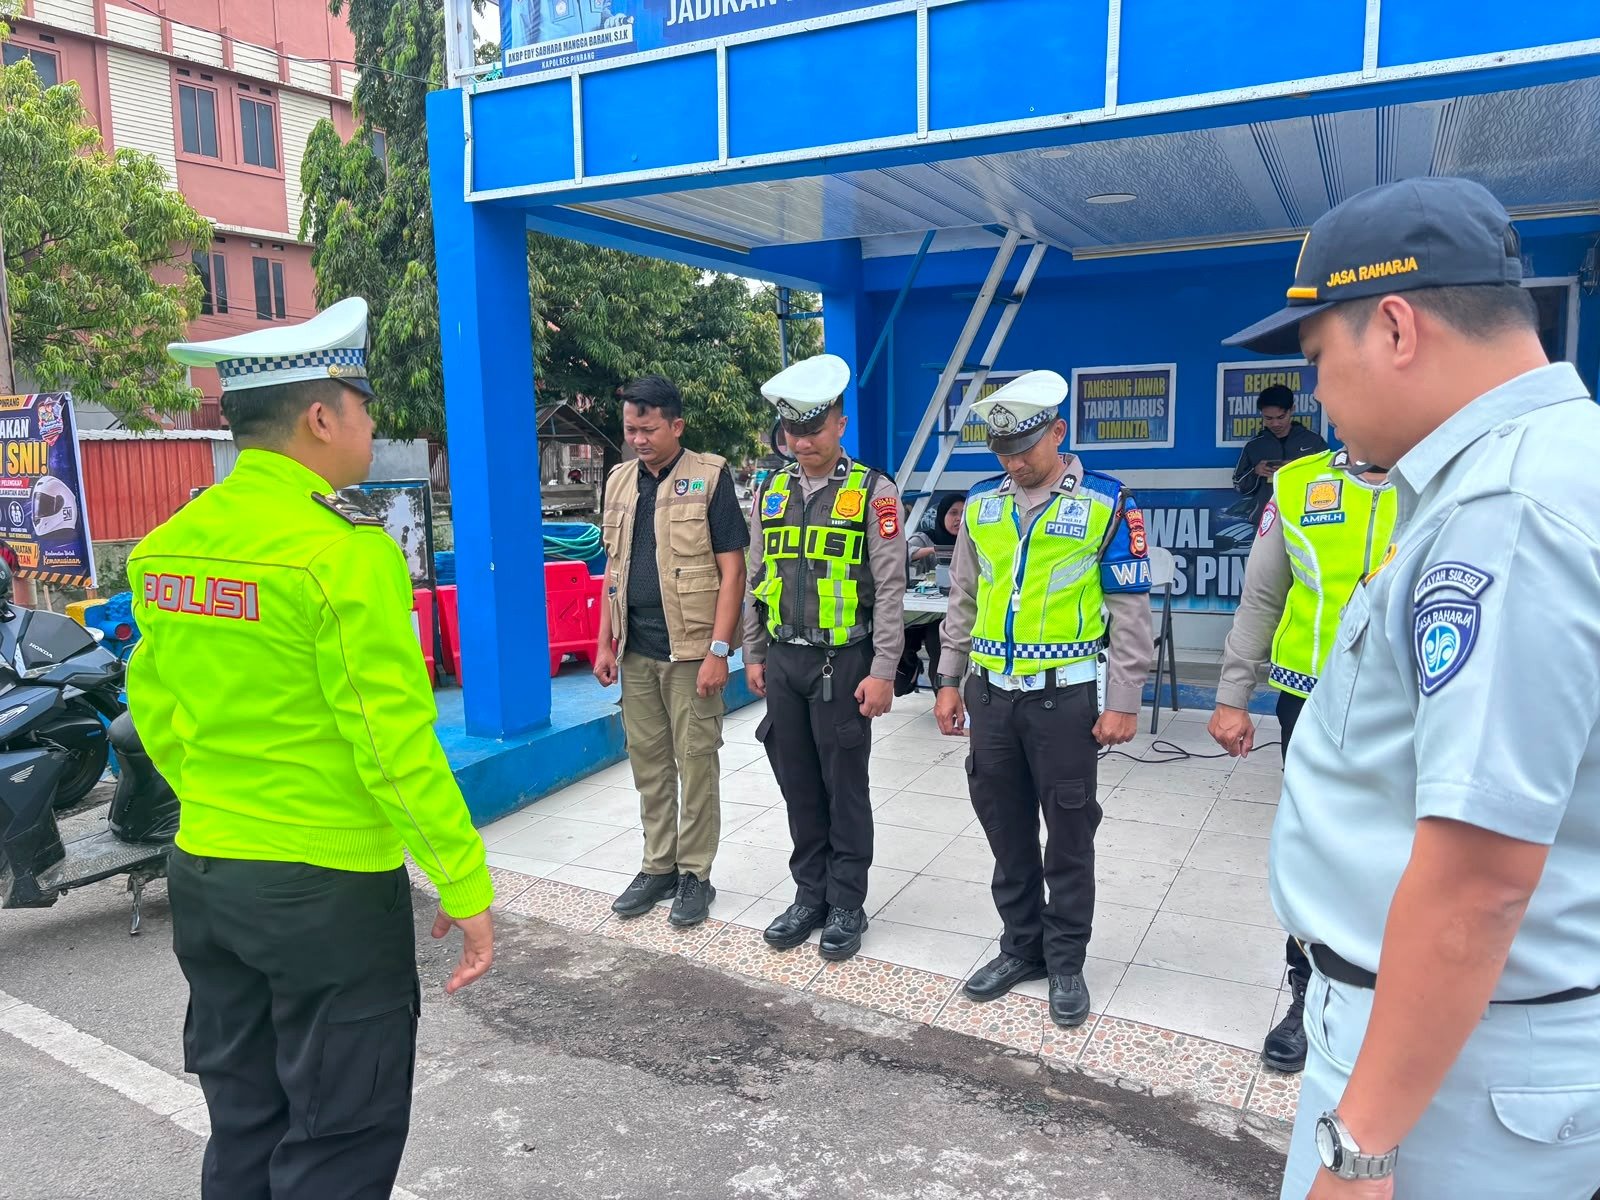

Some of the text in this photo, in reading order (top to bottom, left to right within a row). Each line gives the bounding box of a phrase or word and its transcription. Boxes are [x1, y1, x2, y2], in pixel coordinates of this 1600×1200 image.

[667, 0, 777, 26] JADIK
[508, 52, 523, 63] AKBP
[524, 48, 534, 60] EDY
[535, 43, 562, 57] SABHARA
[563, 37, 588, 51] MANGGA
[613, 29, 629, 41] S.I.K
[541, 51, 595, 69] KAPOLRES PINRANG
[1326, 256, 1419, 287] JASA RAHARJA
[1083, 377, 1165, 398] TANGGUNG JAWAB
[1083, 398, 1164, 419] TANPA HARUS
[1097, 420, 1149, 439] DIMINTA
[7, 442, 48, 475] SNI!
[1302, 513, 1342, 524] AMRI.H
[1046, 523, 1085, 538] POLISI
[1448, 569, 1480, 589] SULSEL
[143, 572, 260, 622] POLISI
[1418, 609, 1473, 633] JASA RAHARJA
[28, 642, 53, 659] HONDA
